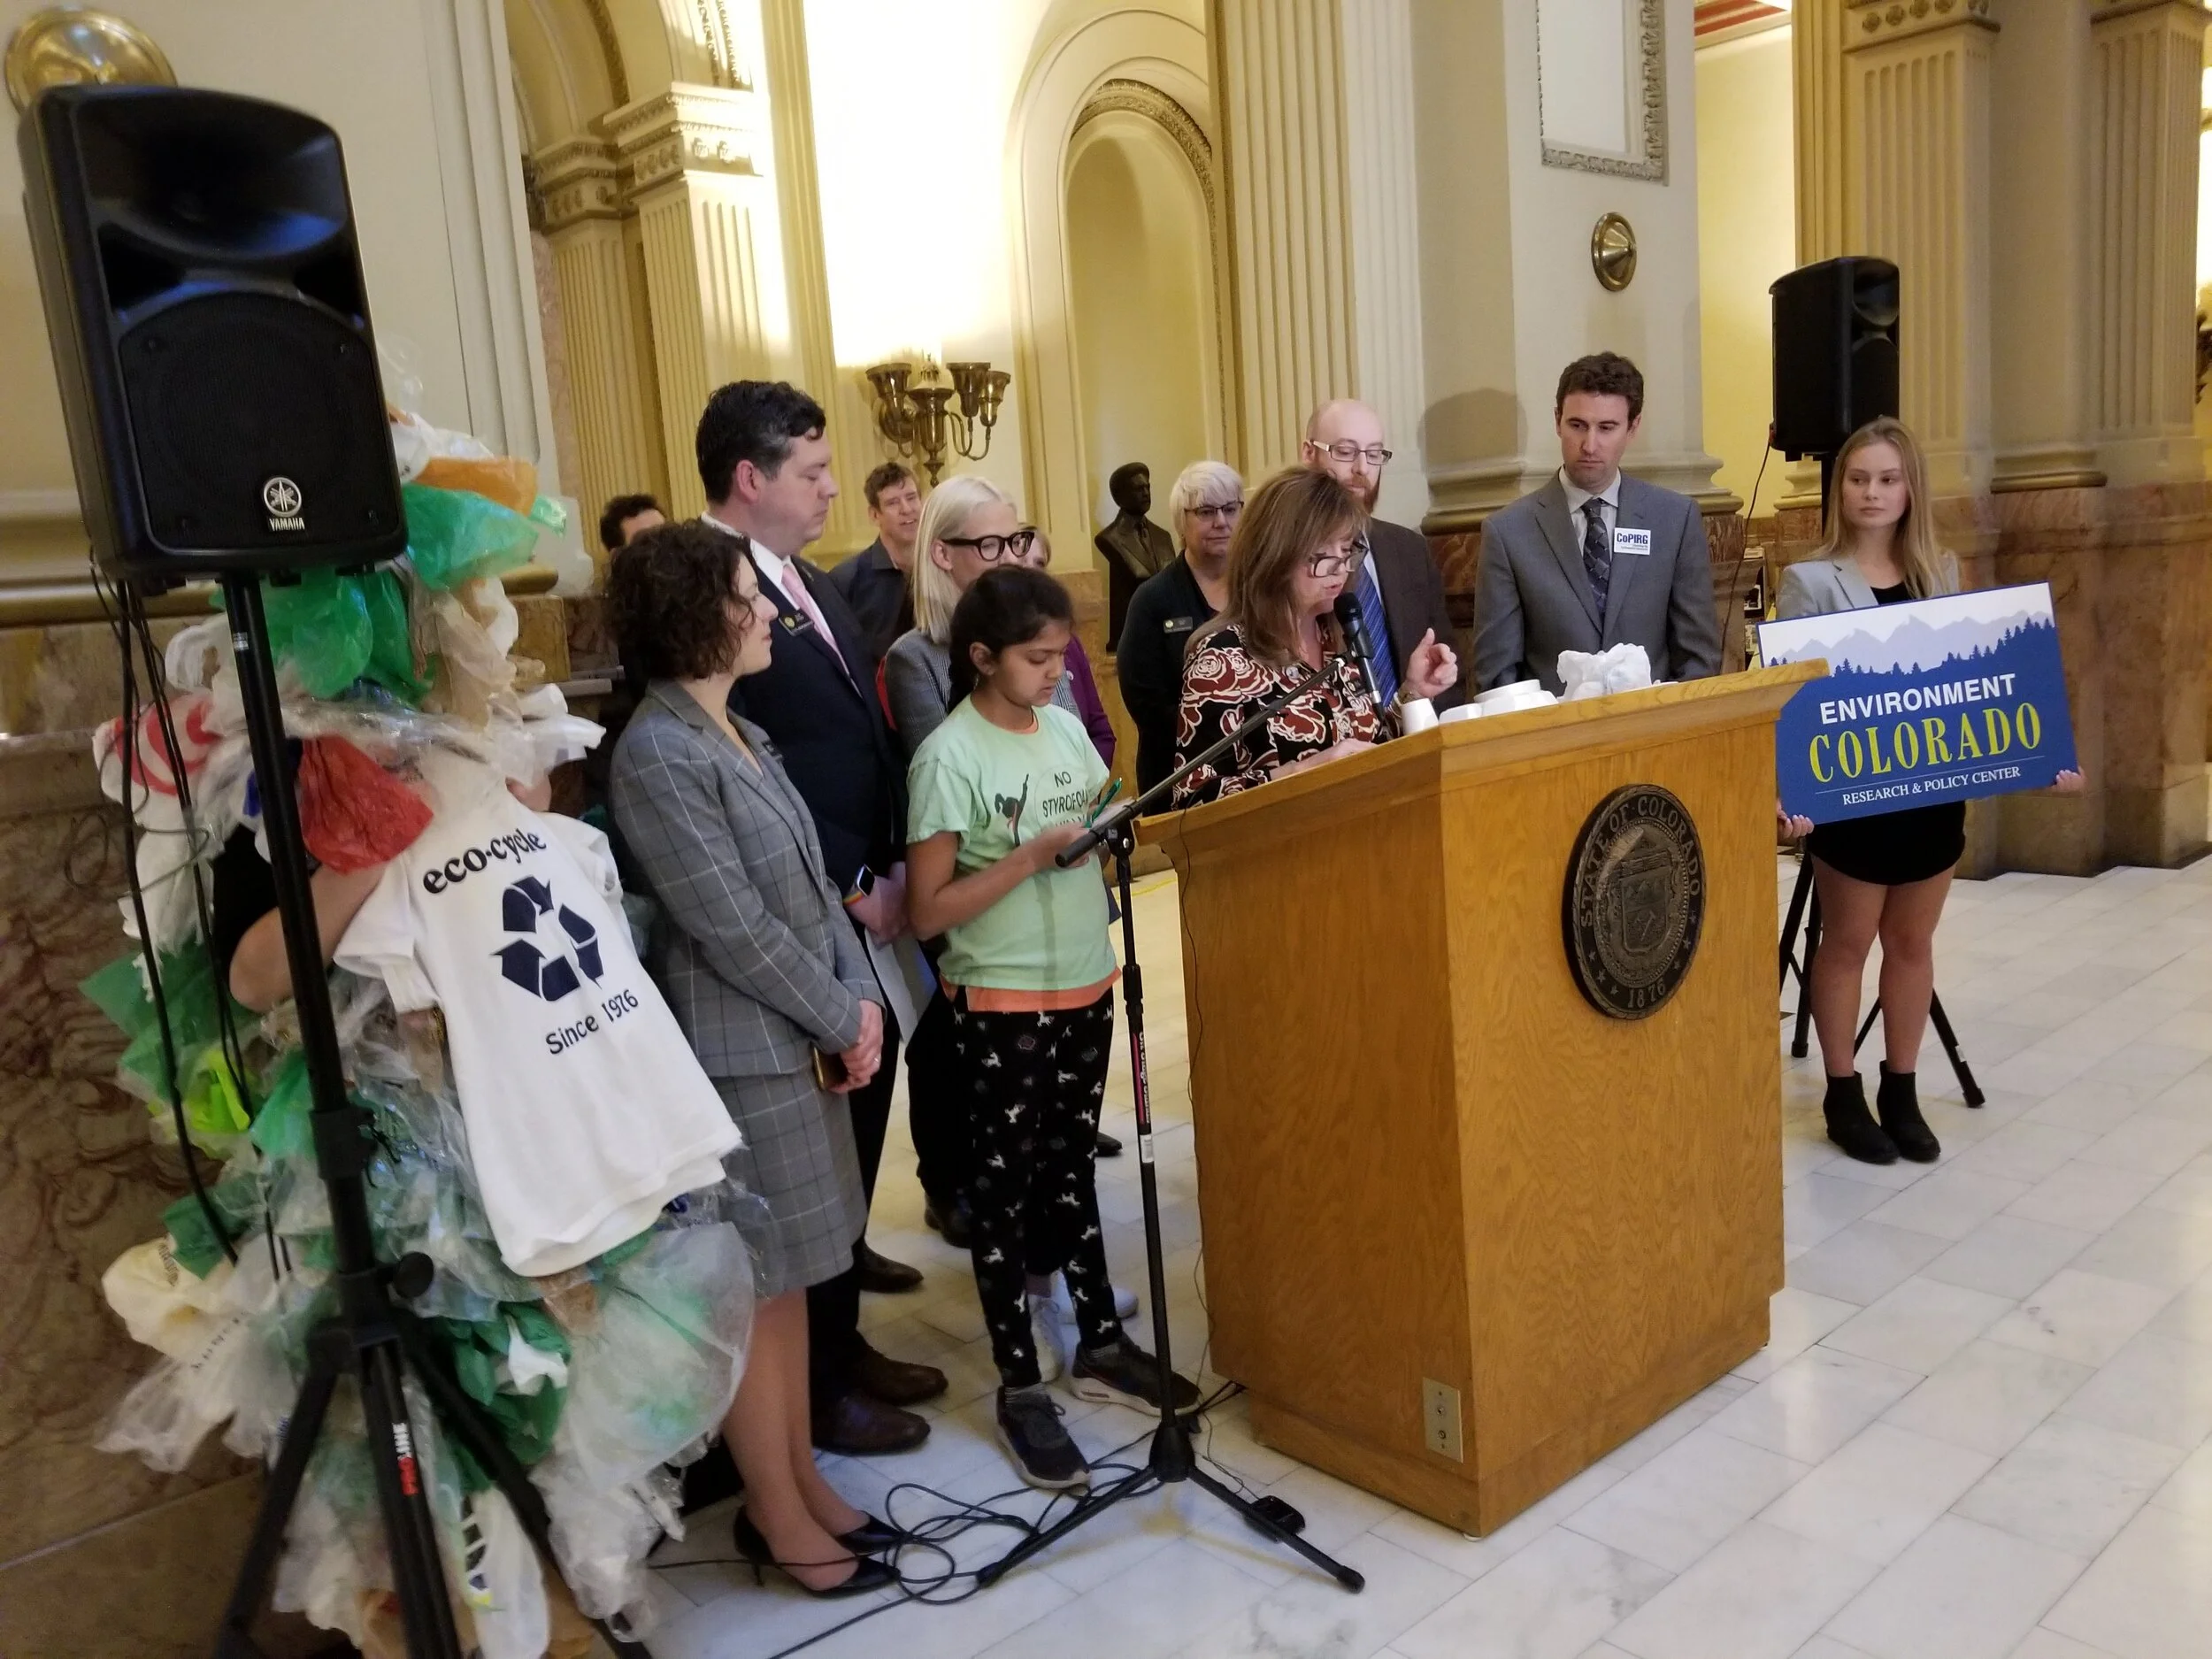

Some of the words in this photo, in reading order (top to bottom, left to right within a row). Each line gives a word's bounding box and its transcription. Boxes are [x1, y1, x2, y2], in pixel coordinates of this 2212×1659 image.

[269, 517, 305, 531] YAMAHA
[1617, 533, 1648, 545] CoPIRG
[1819, 672, 2016, 726] ENVIRONMENT
[1809, 703, 2042, 783] COLORADO
[1054, 771, 1071, 787] NO
[1842, 784, 1909, 805] RESEARCH
[1911, 782, 1923, 795] &
[1924, 773, 1970, 794] POLICY
[1972, 765, 2022, 784] CENTER
[1042, 788, 1089, 817] STYROFO
[1580, 834, 1610, 928] STATE
[1609, 803, 1630, 829] OF
[1637, 795, 1701, 896] COLORADO
[545, 1013, 600, 1055] Since
[602, 988, 640, 1023] 1976
